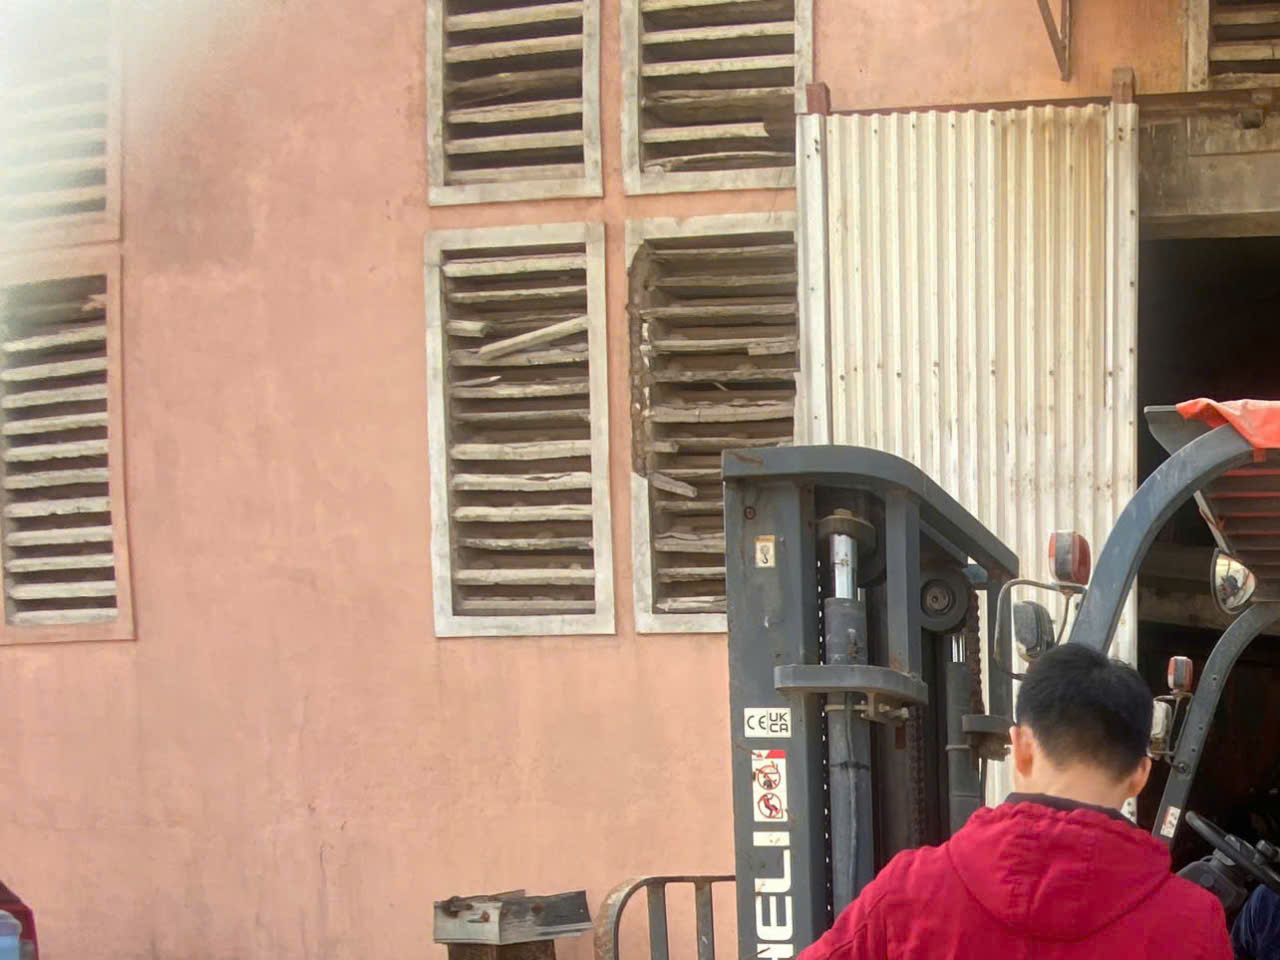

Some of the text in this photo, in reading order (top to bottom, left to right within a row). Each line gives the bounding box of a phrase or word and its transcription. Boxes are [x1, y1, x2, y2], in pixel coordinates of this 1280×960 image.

[769, 712, 787, 722] UK
[747, 715, 766, 730] CE
[769, 723, 789, 733] CA
